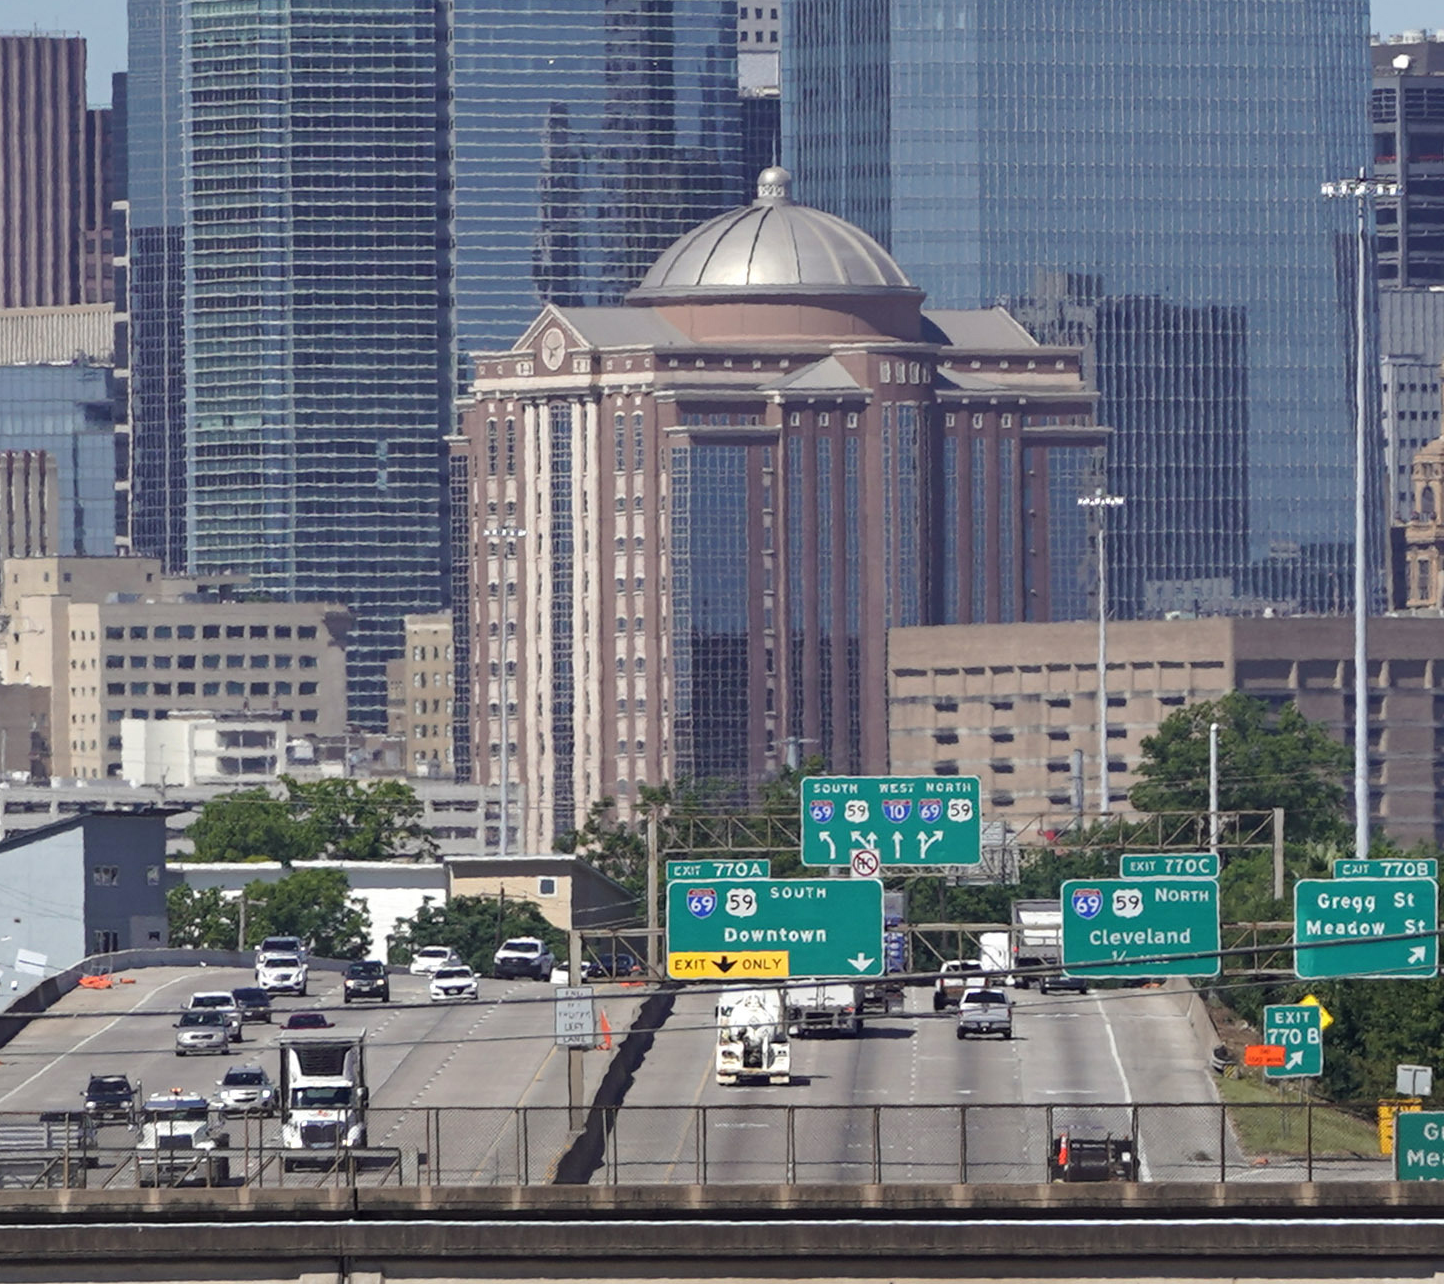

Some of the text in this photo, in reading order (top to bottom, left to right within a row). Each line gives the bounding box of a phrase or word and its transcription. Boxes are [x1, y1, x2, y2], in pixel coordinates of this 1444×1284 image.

[813, 782, 972, 794] SOUTH WEST NORTH
[812, 803, 971, 818] 69 59 10 69 59
[673, 862, 763, 877] EXIT 770A
[1129, 858, 1211, 873] EXIT 770C
[1342, 862, 1429, 877] EXIT 770B
[690, 886, 827, 913] 69 59 SOUTH
[1076, 895, 1100, 914] 69
[1115, 895, 1140, 911] 59
[1317, 892, 1416, 914] Gregg St
[724, 927, 827, 943] Downtown
[1306, 919, 1427, 936] Meadow St
[1089, 927, 1192, 946] Cleveland
[674, 958, 782, 971] EXIT ONLY
[1274, 1011, 1311, 1024] EXIT
[1267, 1027, 1320, 1045] 770 B
